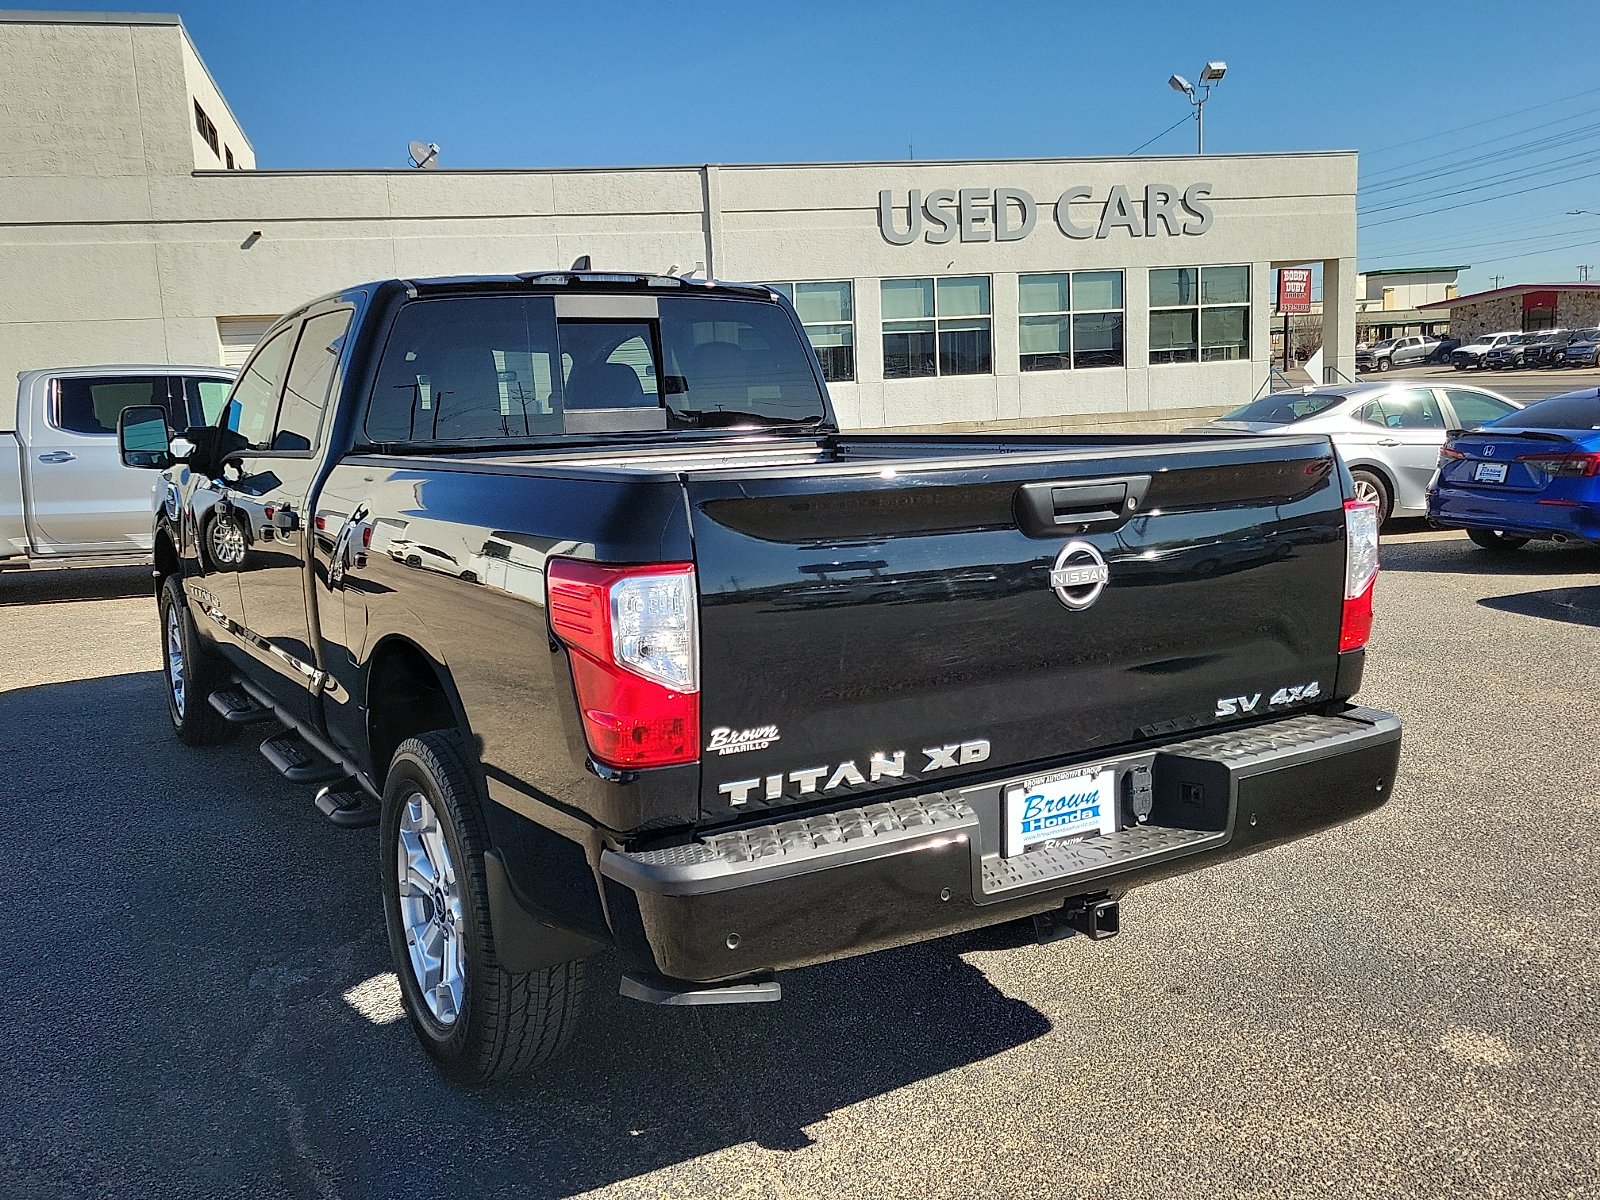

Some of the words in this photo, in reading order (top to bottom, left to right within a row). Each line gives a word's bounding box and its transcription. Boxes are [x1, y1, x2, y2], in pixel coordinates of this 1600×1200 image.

[878, 187, 1037, 246] USED
[1053, 182, 1214, 241] CARS
[1283, 270, 1308, 281] BOBBY
[1285, 282, 1306, 292] DUBY
[1053, 568, 1107, 585] NISSAN
[1215, 693, 1261, 717] SV
[706, 725, 780, 748] Brown
[718, 741, 769, 756] AMARILLO
[718, 751, 906, 807] TITAN
[920, 740, 991, 773] XD
[1046, 769, 1081, 783] AUTOMOTIVE
[1022, 789, 1100, 820] Brown
[1029, 809, 1094, 832] Honda
